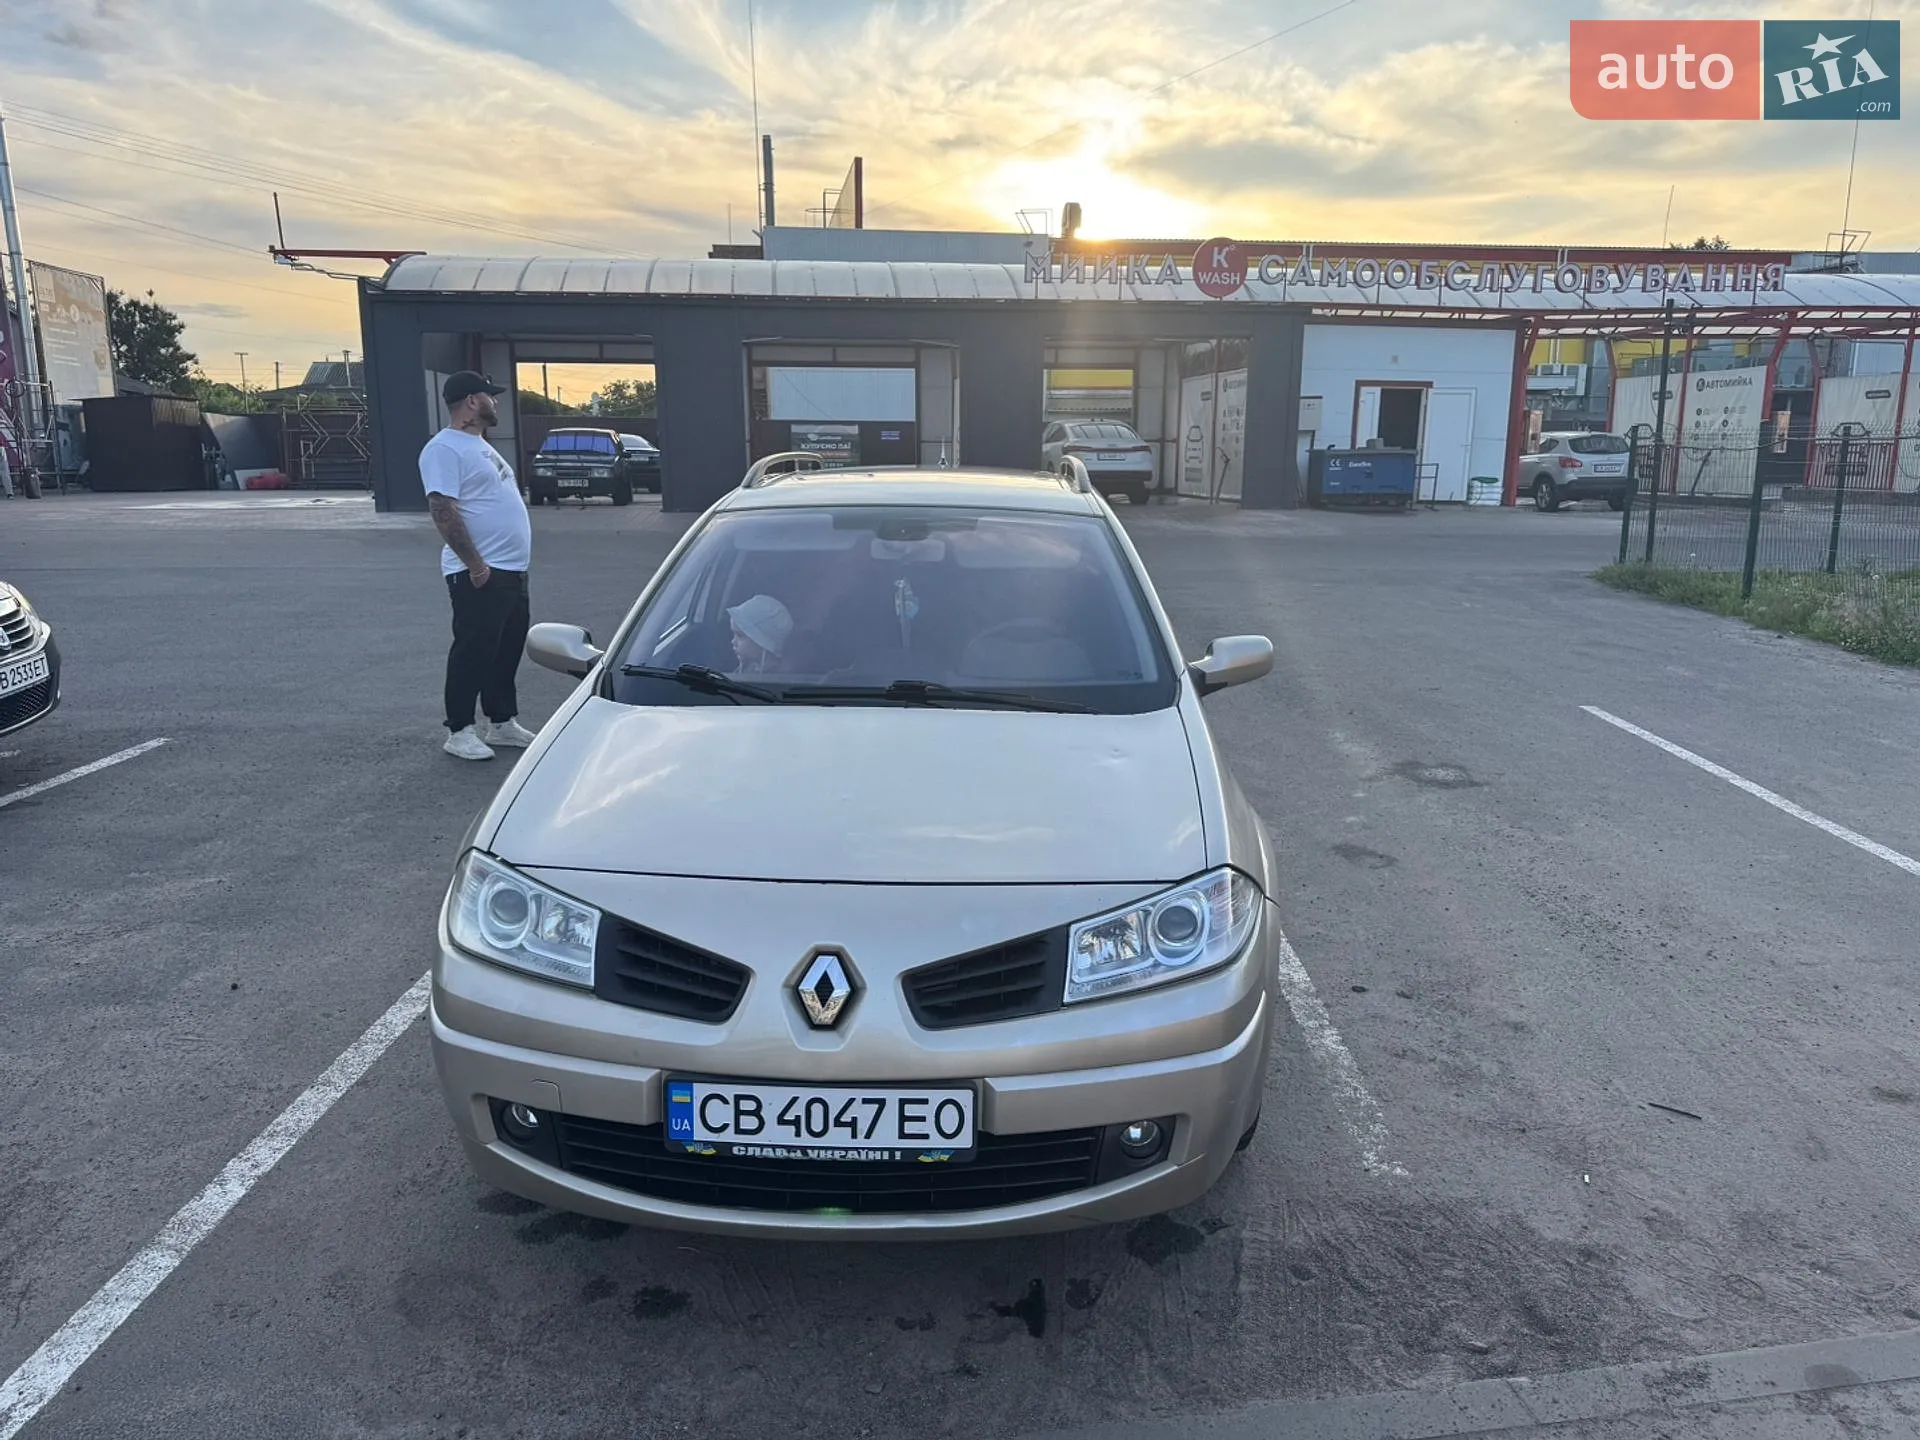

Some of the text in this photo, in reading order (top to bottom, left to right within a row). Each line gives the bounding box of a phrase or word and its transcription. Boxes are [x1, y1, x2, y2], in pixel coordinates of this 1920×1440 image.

[1024, 250, 1786, 294] МИЙКА САМООБСЛУГОВУВАННЯ
[1198, 272, 1240, 286] WASH
[1706, 376, 1753, 389] АВТОМИЙКА
[699, 1093, 966, 1140] CB 4047 EO
[672, 1118, 692, 1132] UA
